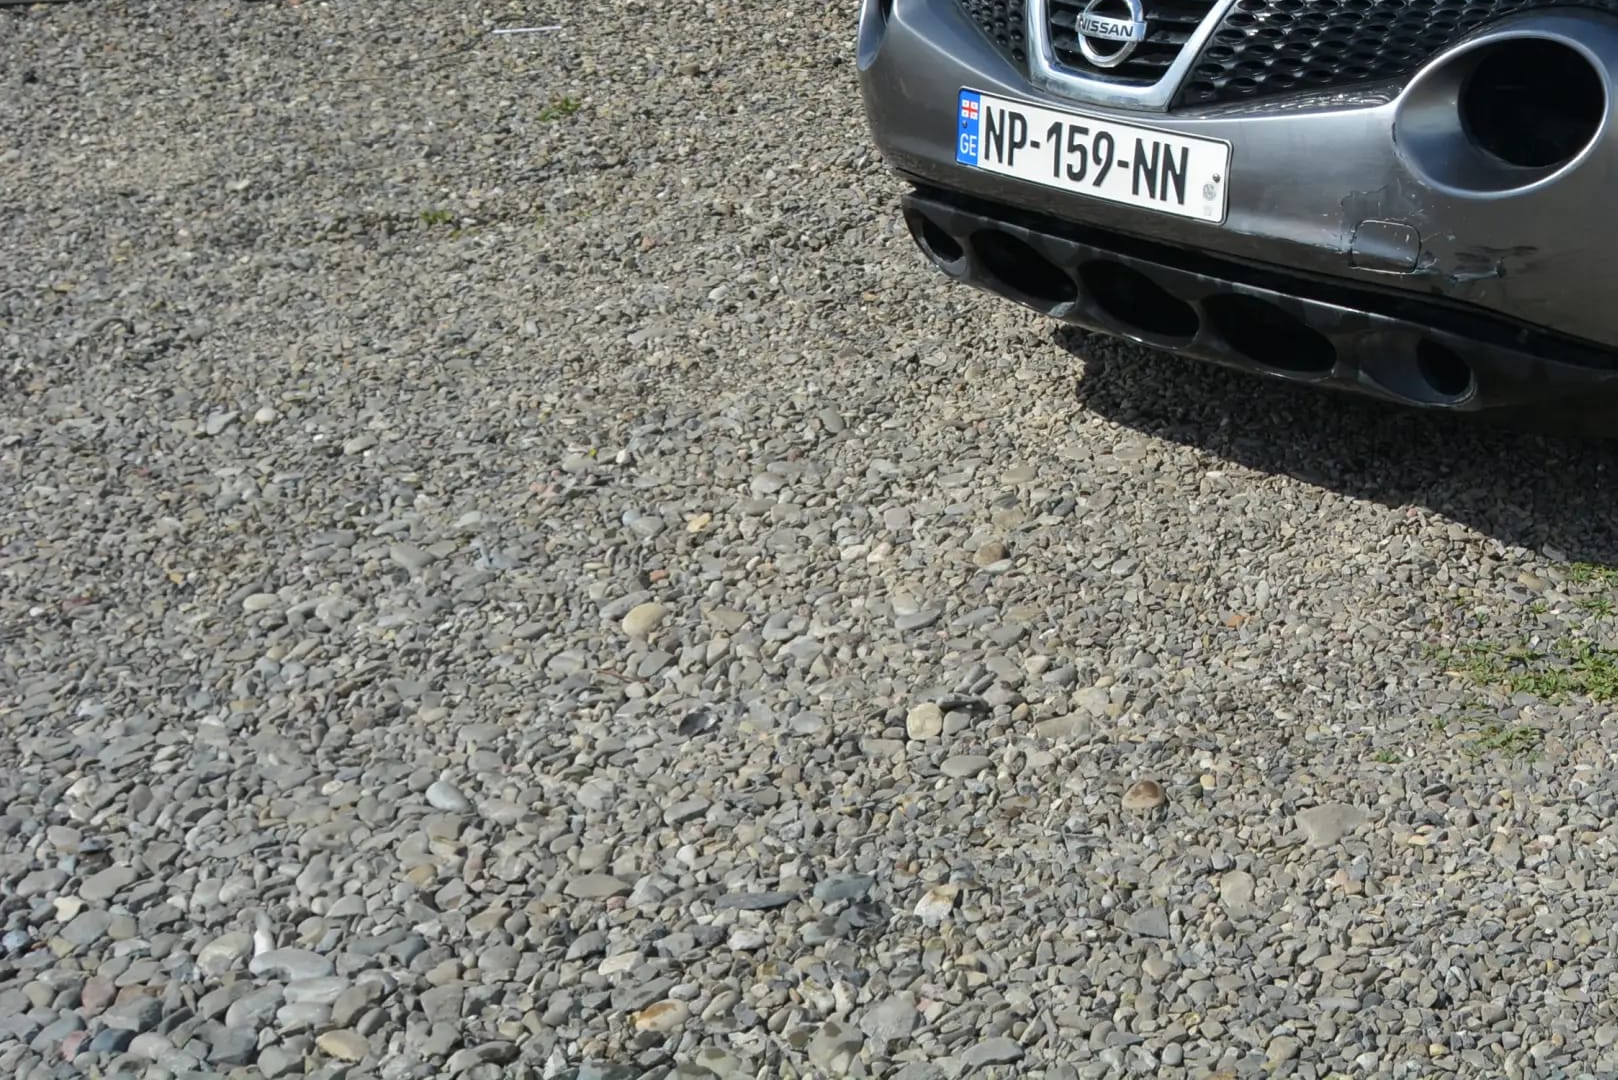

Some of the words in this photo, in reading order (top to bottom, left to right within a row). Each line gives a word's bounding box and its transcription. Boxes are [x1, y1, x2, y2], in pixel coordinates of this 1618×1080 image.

[1078, 17, 1134, 38] NISSAN
[959, 133, 977, 156] GE
[984, 105, 1190, 205] NP-159-NN
